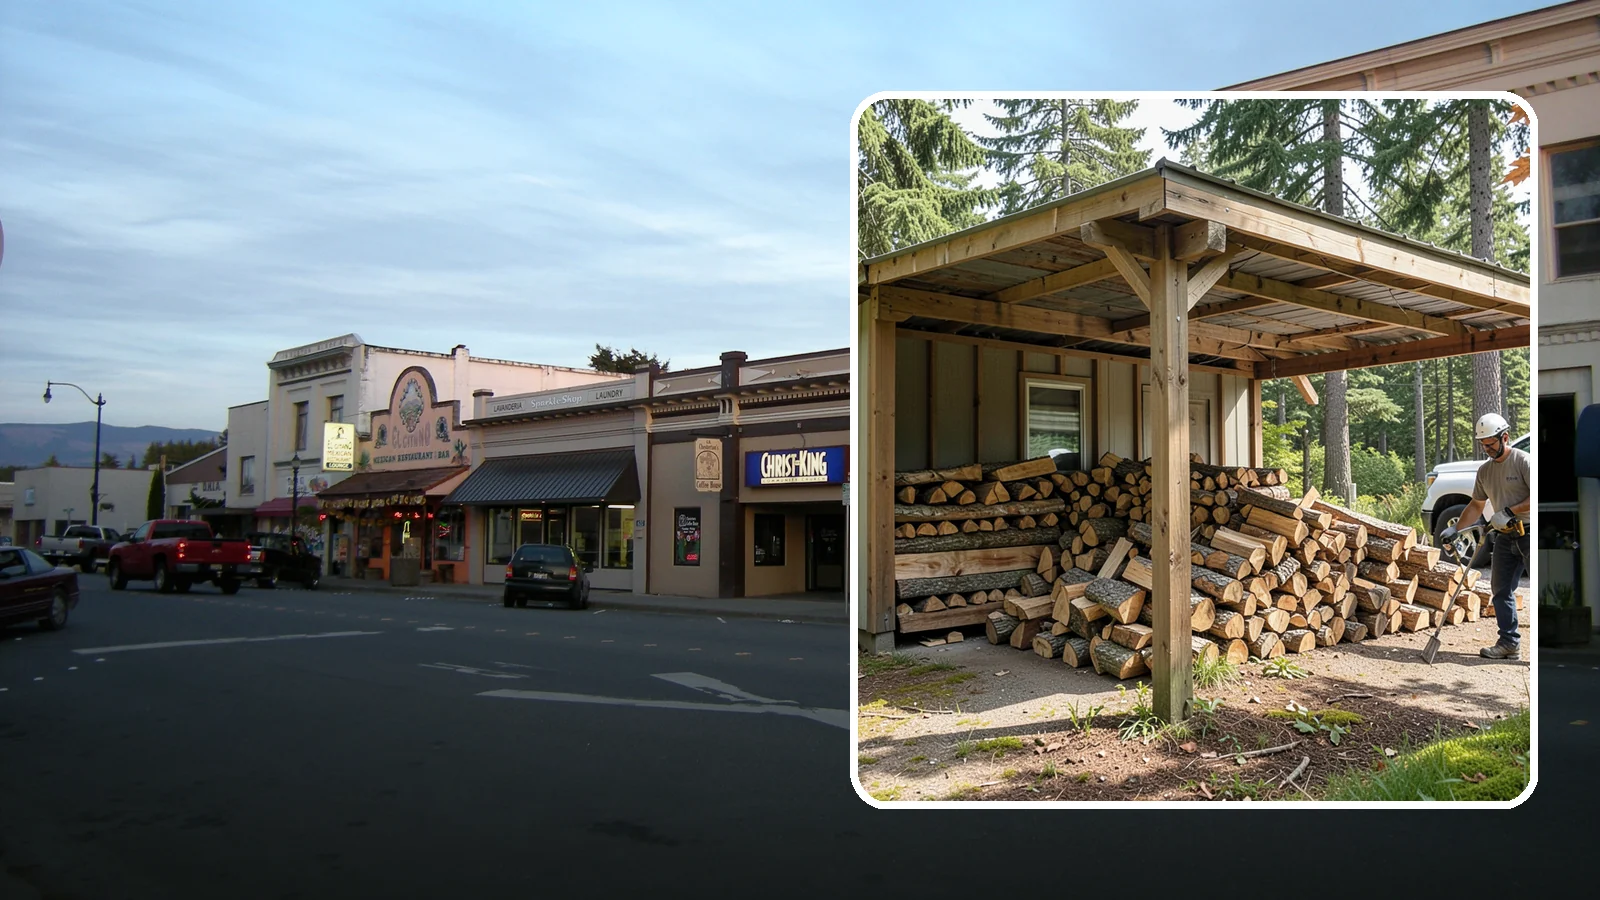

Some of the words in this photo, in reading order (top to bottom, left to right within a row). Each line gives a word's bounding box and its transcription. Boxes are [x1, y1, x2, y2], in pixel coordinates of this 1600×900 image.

[531, 397, 562, 408] Sparkle
[562, 394, 582, 405] Shop
[595, 389, 623, 400] LAUNDRY
[493, 401, 522, 412] LAVANDERIA
[392, 426, 401, 449] EL
[374, 455, 396, 464] MEXICAN
[398, 451, 433, 462] RESTAURANT
[438, 450, 450, 459] BAR
[761, 452, 797, 478] CHRIST
[799, 450, 827, 476] KING
